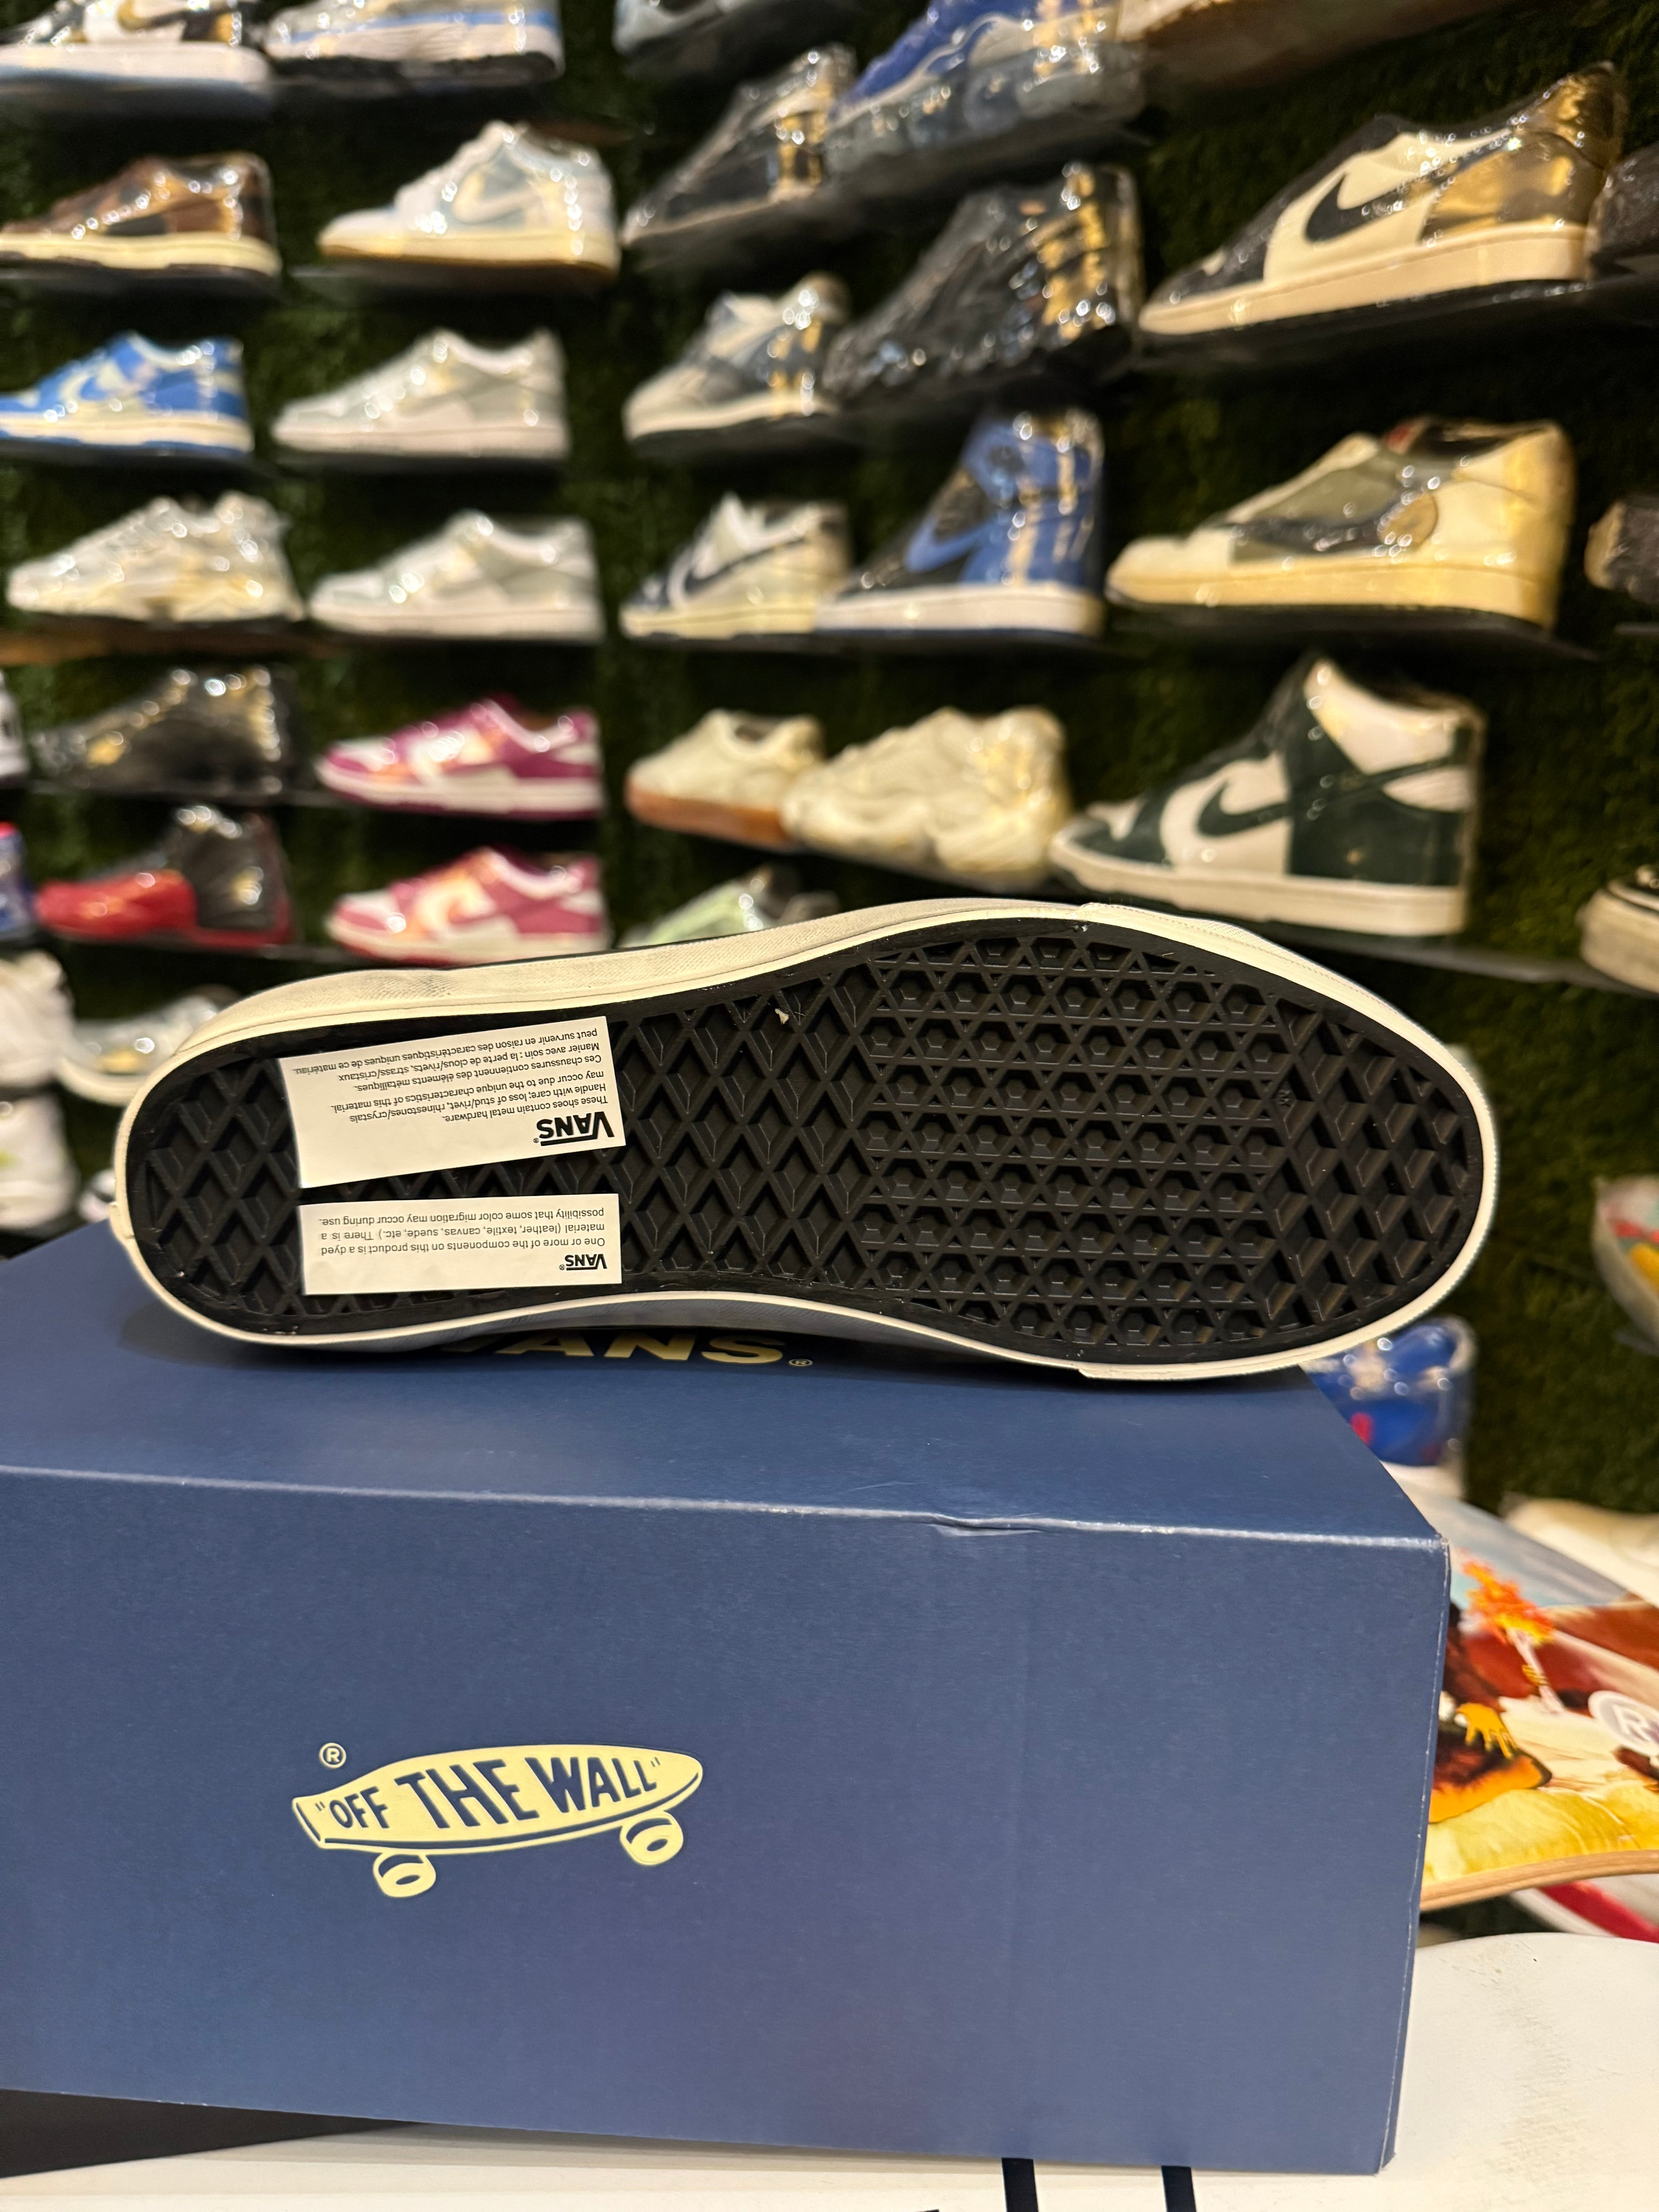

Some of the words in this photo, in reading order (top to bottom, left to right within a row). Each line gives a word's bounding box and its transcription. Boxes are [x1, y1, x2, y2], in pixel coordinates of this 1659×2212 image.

[538, 1033, 575, 1045] survenir
[576, 1028, 597, 1040] peut
[477, 1043, 494, 1052] des
[495, 1039, 524, 1049] raison
[568, 1042, 600, 1053] Manier
[524, 1049, 544, 1059] soin
[545, 1046, 566, 1055] avec
[363, 1055, 401, 1066] uniques
[469, 1057, 482, 1067] de
[482, 1052, 509, 1064] perte
[509, 1052, 519, 1062] la
[584, 1055, 602, 1063] Ces
[350, 1060, 363, 1069] de
[531, 1057, 583, 1069] chaussures
[455, 1071, 473, 1080] des
[473, 1064, 529, 1078] contiennent
[585, 1070, 604, 1079] may
[526, 1079, 537, 1087] to
[537, 1077, 556, 1087] due
[557, 1073, 584, 1083] occur
[475, 1083, 508, 1093] unique
[509, 1081, 525, 1090] the
[574, 1083, 606, 1095] Handle
[404, 1087, 475, 1103] characteristics
[508, 1093, 528, 1102] loss
[528, 1090, 552, 1099] care;
[553, 1087, 574, 1098] with
[373, 1098, 392, 1108] this
[393, 1096, 404, 1106] of
[497, 1096, 507, 1106] of
[552, 1099, 579, 1108] shoes
[580, 1095, 609, 1105] These
[330, 1100, 372, 1114] material.
[516, 1102, 551, 1114] contain
[441, 1110, 489, 1122] hardware.
[489, 1107, 515, 1119] metal
[406, 1214, 428, 1223] may
[429, 1212, 477, 1224] migration
[478, 1212, 503, 1222] color
[505, 1211, 533, 1220] some
[534, 1211, 553, 1220] that
[556, 1207, 604, 1220] possibility
[343, 1215, 375, 1227] during
[376, 1216, 405, 1224] occur
[440, 1227, 481, 1236] canvas,
[483, 1226, 517, 1236] textile,
[519, 1222, 561, 1235] (leather,
[565, 1224, 605, 1233] material
[331, 1233, 341, 1241] is
[343, 1231, 375, 1241] There
[378, 1228, 401, 1240] etc.)
[404, 1229, 439, 1239] suede,
[447, 1239, 510, 1251] components
[512, 1240, 528, 1249] the
[530, 1239, 540, 1249] of
[584, 1237, 605, 1247] One
[321, 1244, 346, 1256] dyed
[357, 1246, 367, 1255] is
[368, 1242, 408, 1254] product
[410, 1243, 429, 1253] this
[394, 1758, 540, 1829] THE
